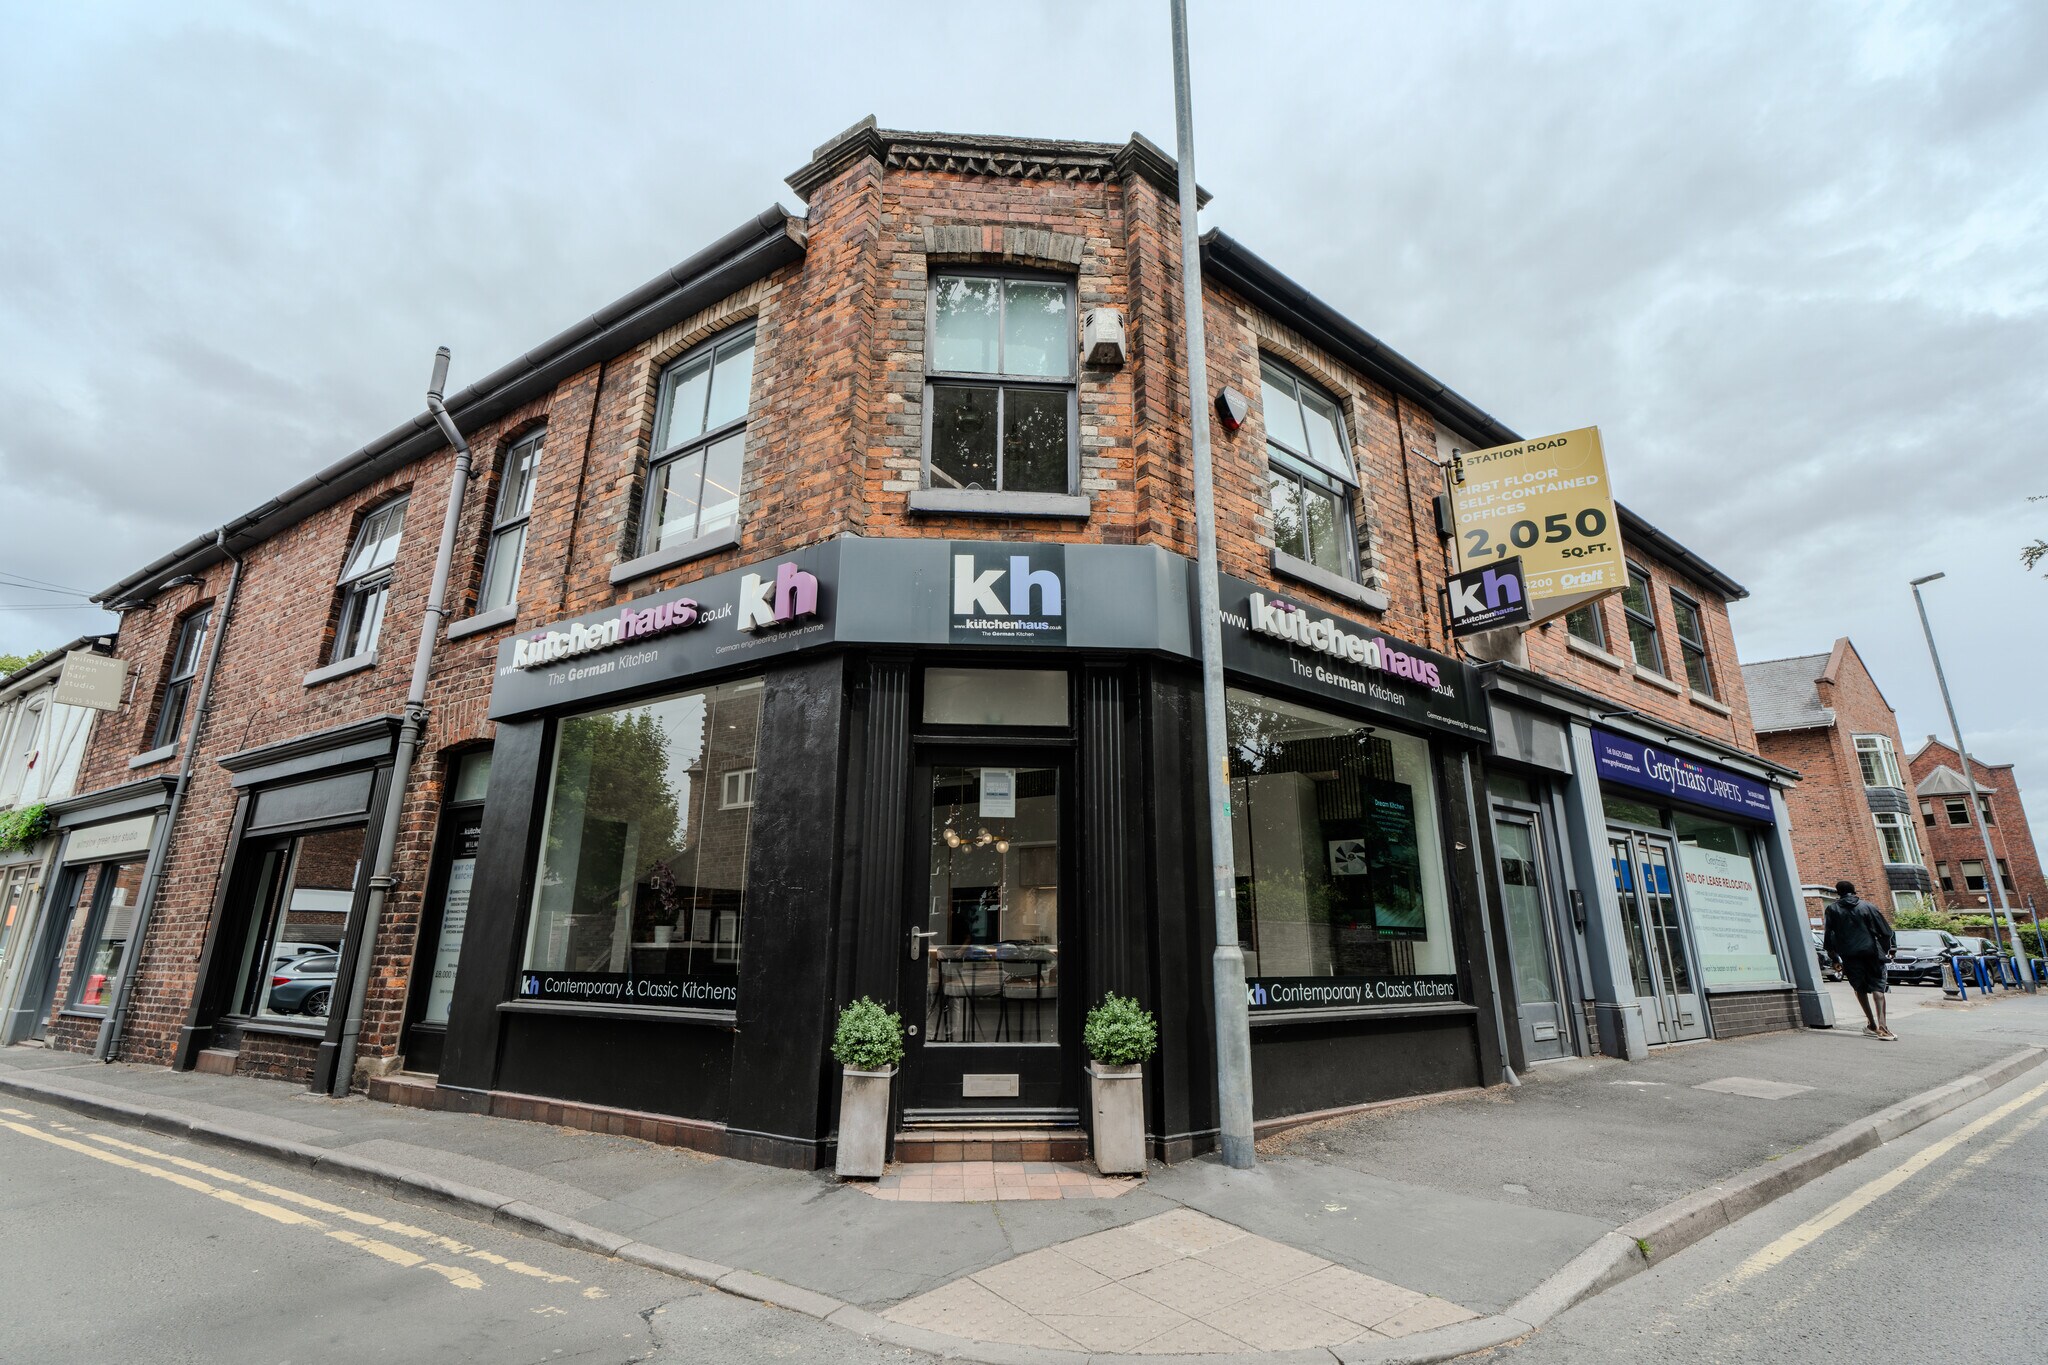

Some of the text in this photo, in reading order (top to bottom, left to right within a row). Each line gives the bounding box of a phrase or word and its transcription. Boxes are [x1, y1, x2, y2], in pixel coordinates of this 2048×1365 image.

[1466, 447, 1524, 466] STATION
[1527, 437, 1568, 453] ROAD
[1457, 468, 1560, 497] FIRST FLOOR
[1458, 475, 1599, 510] SELF-CONTAINED
[1460, 502, 1527, 524] OFFICES
[1463, 508, 1607, 558] 2,050
[1561, 542, 1612, 558] SQ.FT.
[954, 554, 1062, 616] kh
[1560, 569, 1604, 587] Orbit
[737, 562, 819, 634] kh
[1448, 568, 1522, 619] kh
[715, 623, 825, 655] German engineering for your home
[66, 671, 87, 679] hair
[68, 664, 97, 673] green
[72, 655, 117, 668] wilmslow
[548, 650, 658, 686] The German Kitchen
[64, 680, 96, 690] studio
[1290, 657, 1406, 706] The German Kitchen
[1644, 748, 1742, 802] Greyfriars CARPETS
[1685, 872, 1753, 892] END OF LEASE RELOCATION
[520, 975, 540, 995] kh
[544, 977, 738, 1001] Contemporary & Classic Kitchens
[1270, 980, 1455, 1005] Contemporary & Classic Kitchens
